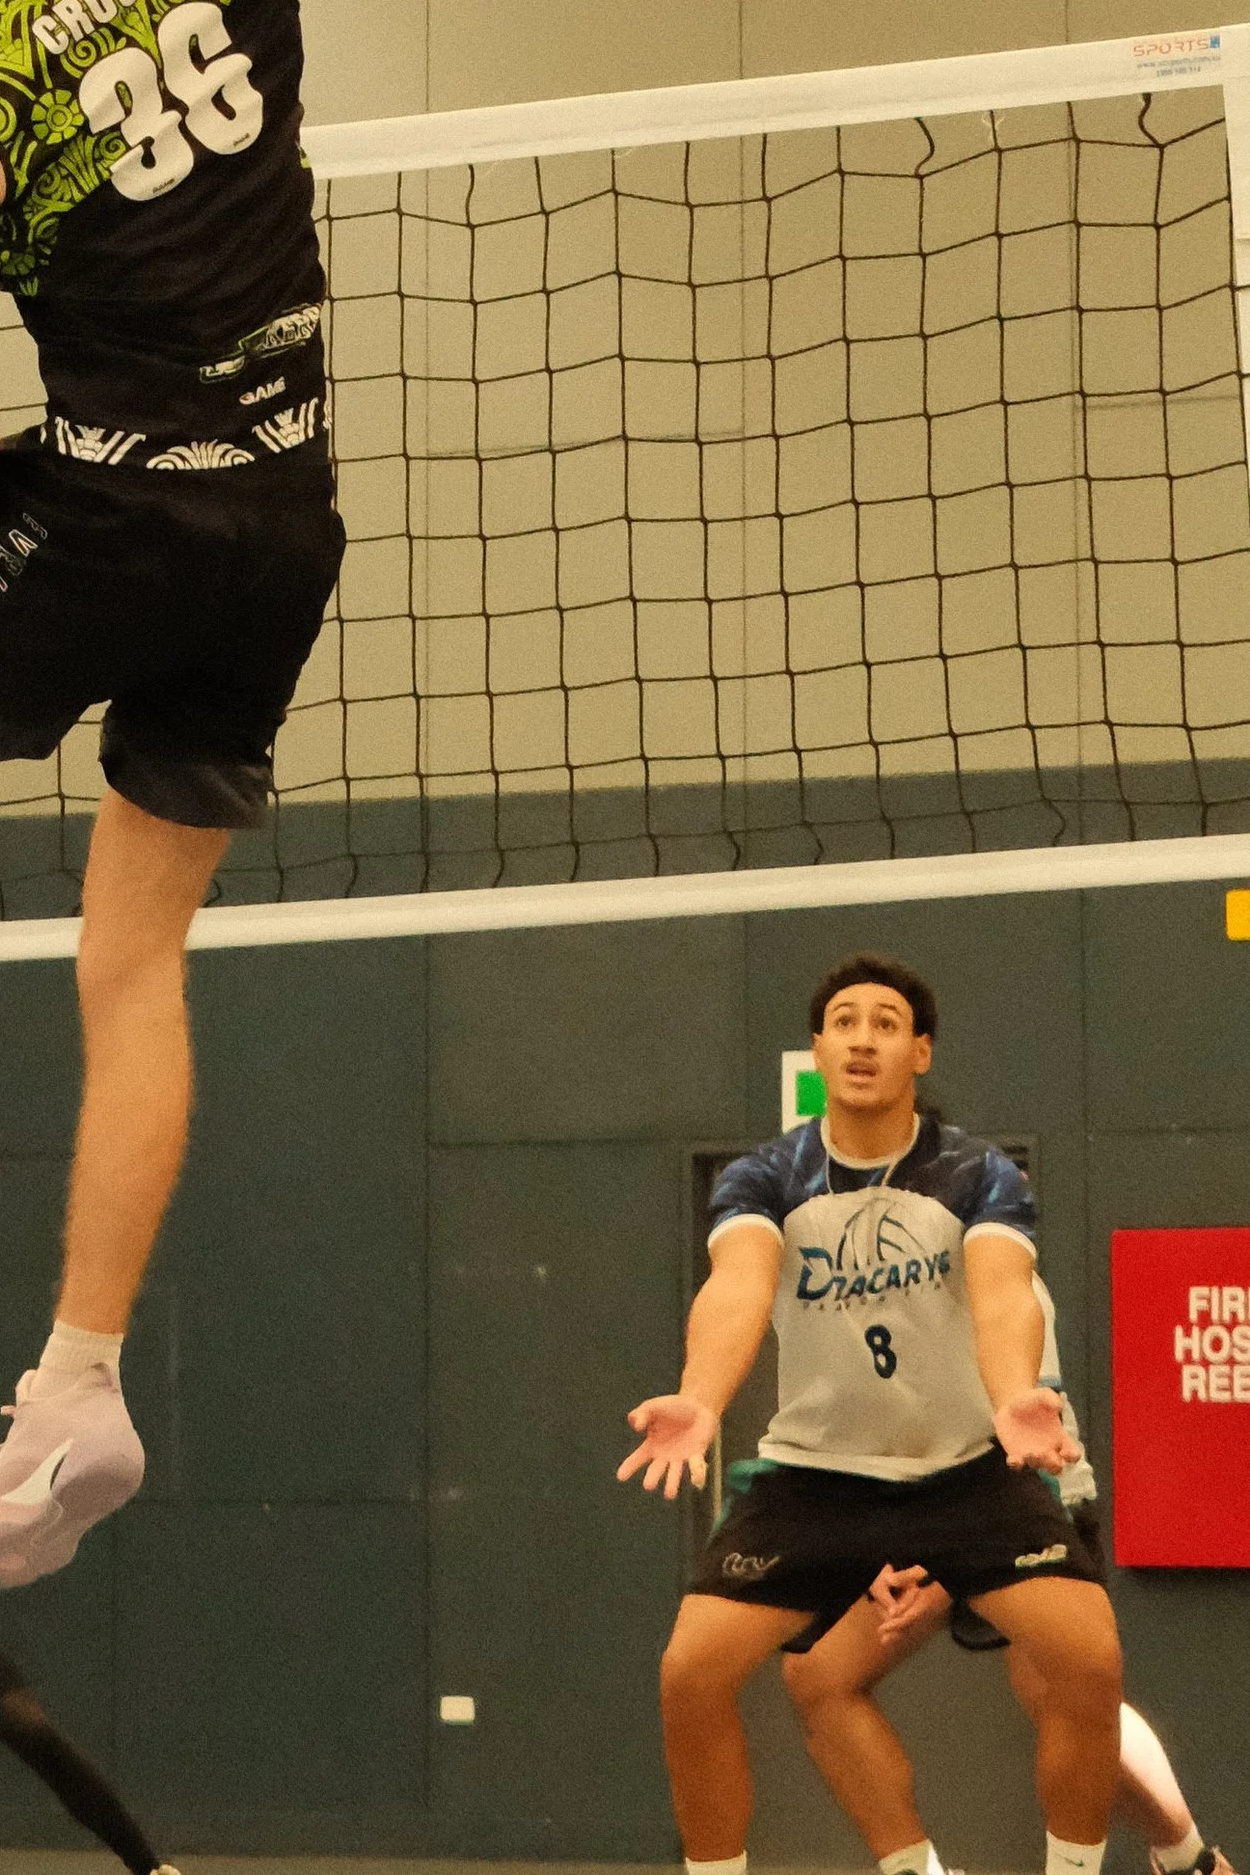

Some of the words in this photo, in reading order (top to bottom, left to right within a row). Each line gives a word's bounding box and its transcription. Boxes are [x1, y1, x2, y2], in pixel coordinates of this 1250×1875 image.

[78, 1, 264, 201] 36
[1188, 1285, 1250, 1325] FIR
[864, 1324, 897, 1379] 8
